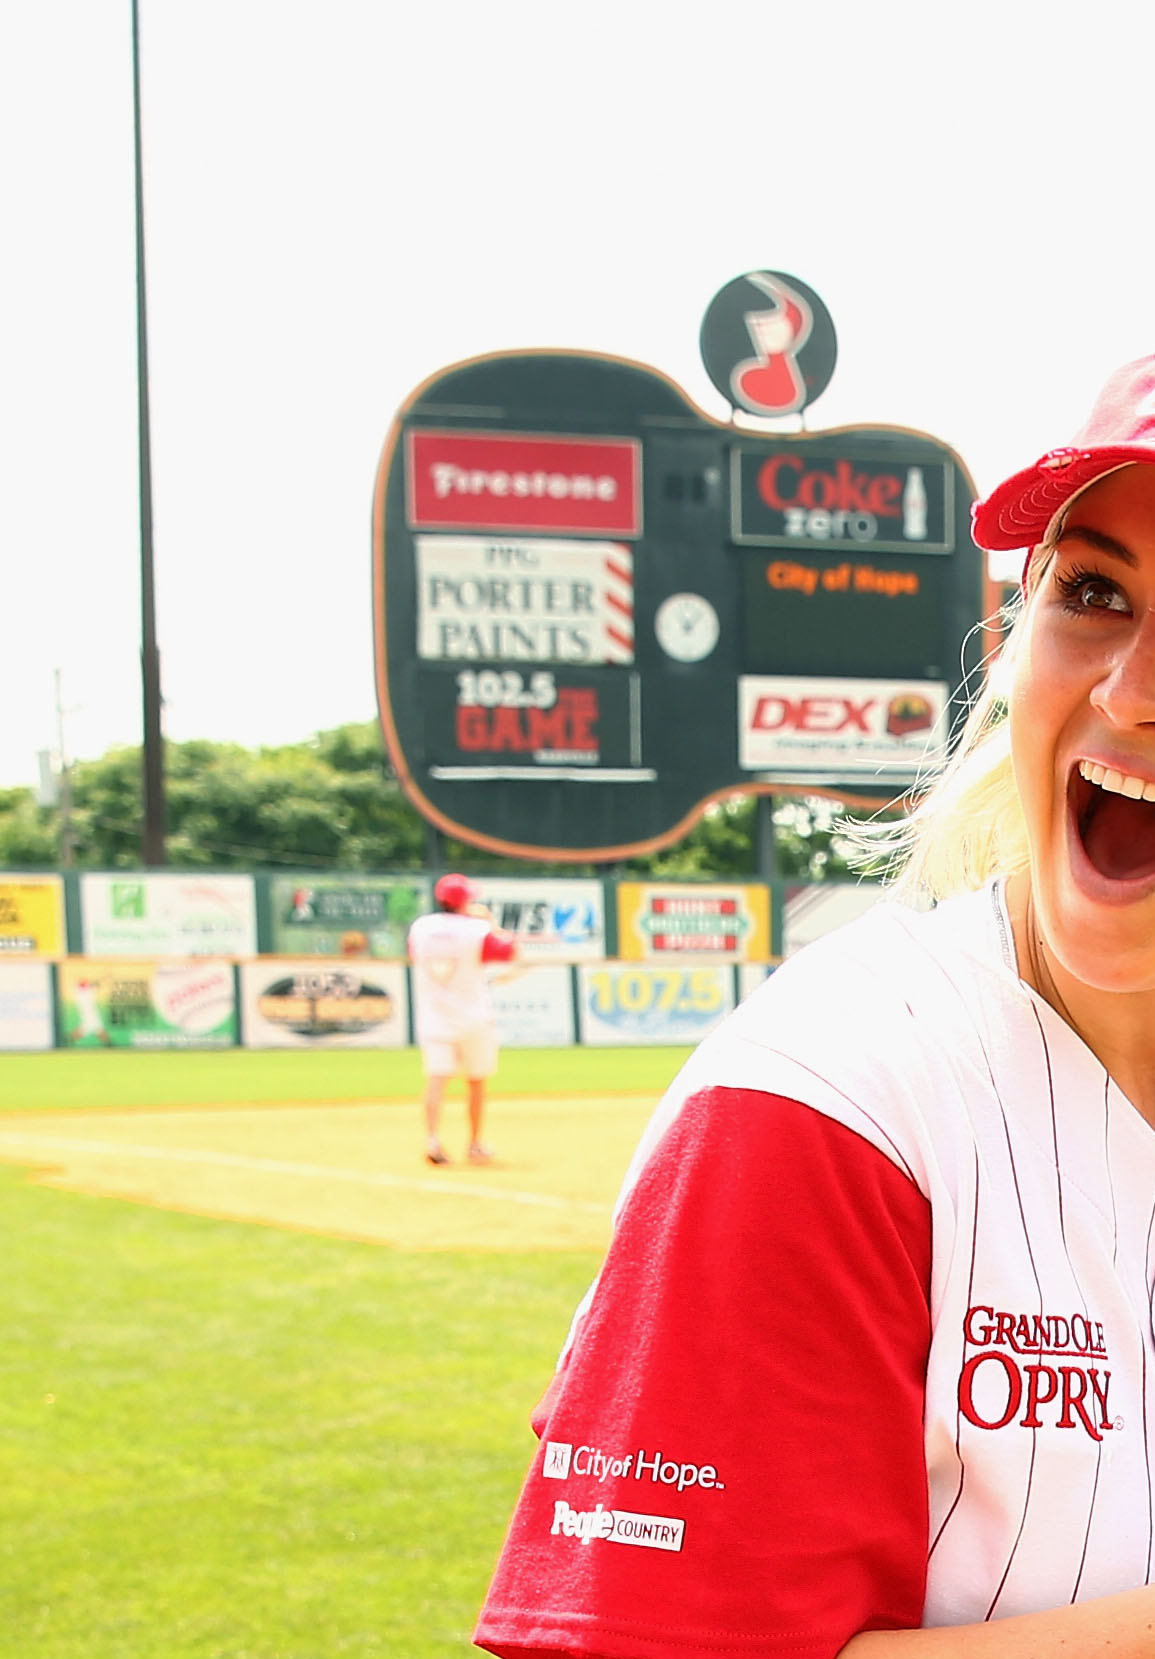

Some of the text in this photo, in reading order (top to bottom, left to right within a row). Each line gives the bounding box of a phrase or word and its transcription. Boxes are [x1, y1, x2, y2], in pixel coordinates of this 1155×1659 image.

[430, 461, 619, 502] Firestone
[757, 453, 904, 518] Coke
[783, 506, 879, 542] zero
[429, 577, 595, 614] PORTER
[767, 560, 920, 597] City of Hope
[436, 622, 592, 656] PAINTS
[456, 670, 558, 708] 102.5
[456, 703, 600, 753] GAME
[751, 694, 877, 735] DEX
[589, 969, 723, 1013] 107.5
[963, 1305, 1107, 1355] GRAND OLE
[957, 1350, 1114, 1442] OPRY
[572, 1445, 615, 1483] City
[610, 1454, 635, 1479] of
[550, 1500, 614, 1546] People
[616, 1518, 681, 1545] COUNTRY
